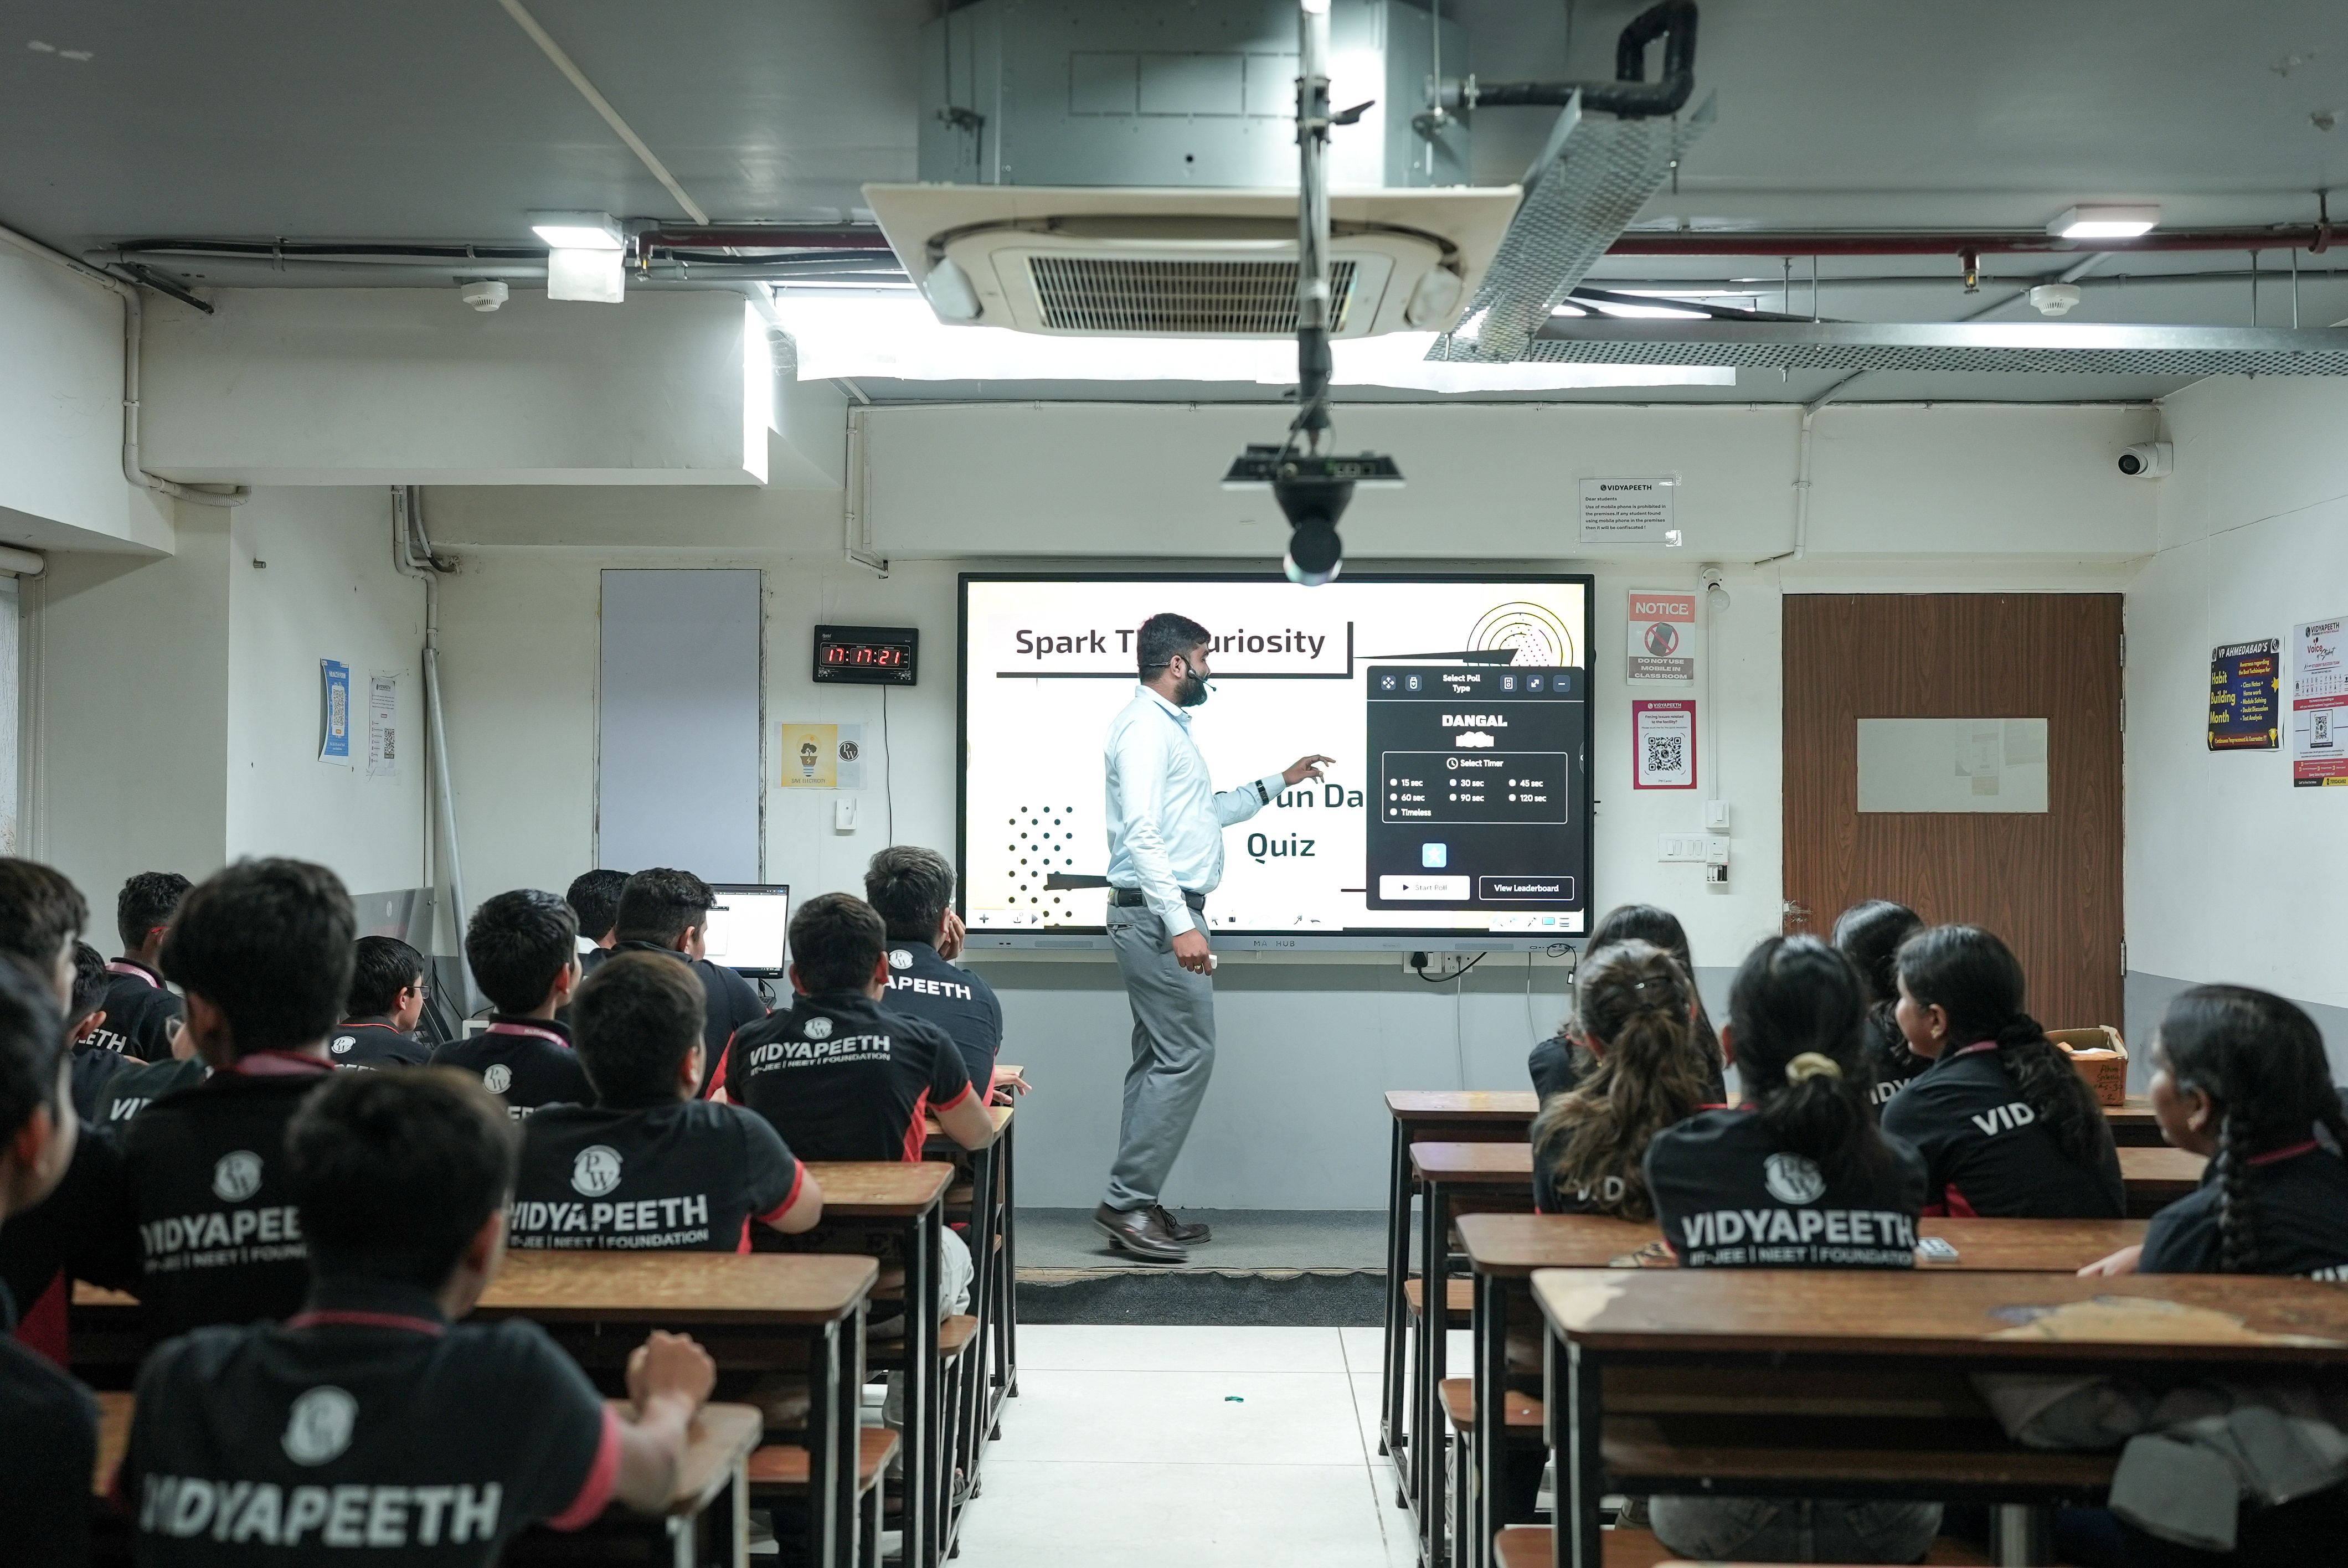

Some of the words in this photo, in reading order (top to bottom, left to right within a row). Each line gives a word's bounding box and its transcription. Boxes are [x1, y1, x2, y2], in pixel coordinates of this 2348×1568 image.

[1635, 602, 1688, 615] NOTICE
[2311, 622, 2339, 633] VIDYAPEETH
[1016, 630, 1106, 659] Spark
[1115, 630, 1135, 653] T
[1208, 628, 1325, 659] uriosity
[2226, 642, 2268, 657] AHMEDABAD'S
[2307, 643, 2323, 653] Voice
[1443, 674, 1466, 683] Select
[2211, 670, 2227, 685] Habit
[1452, 684, 1470, 693] Type
[2211, 690, 2236, 706] Building
[1442, 715, 1508, 727] DANGAL
[2210, 709, 2229, 724] Month
[1325, 784, 1363, 808] Da
[1247, 833, 1315, 864] Quiz
[883, 974, 971, 1000] APEETH
[78, 1028, 127, 1053] ETH
[750, 1035, 890, 1066] VIDYAPEETH
[787, 1059, 816, 1067] NEET
[822, 1052, 891, 1065] FOUNDATION
[1972, 1102, 2035, 1136] VID
[1681, 1208, 1916, 1248] VIDYAPEETH
[607, 1229, 709, 1249] FOUNDATION
[1758, 1247, 1808, 1263] NEET
